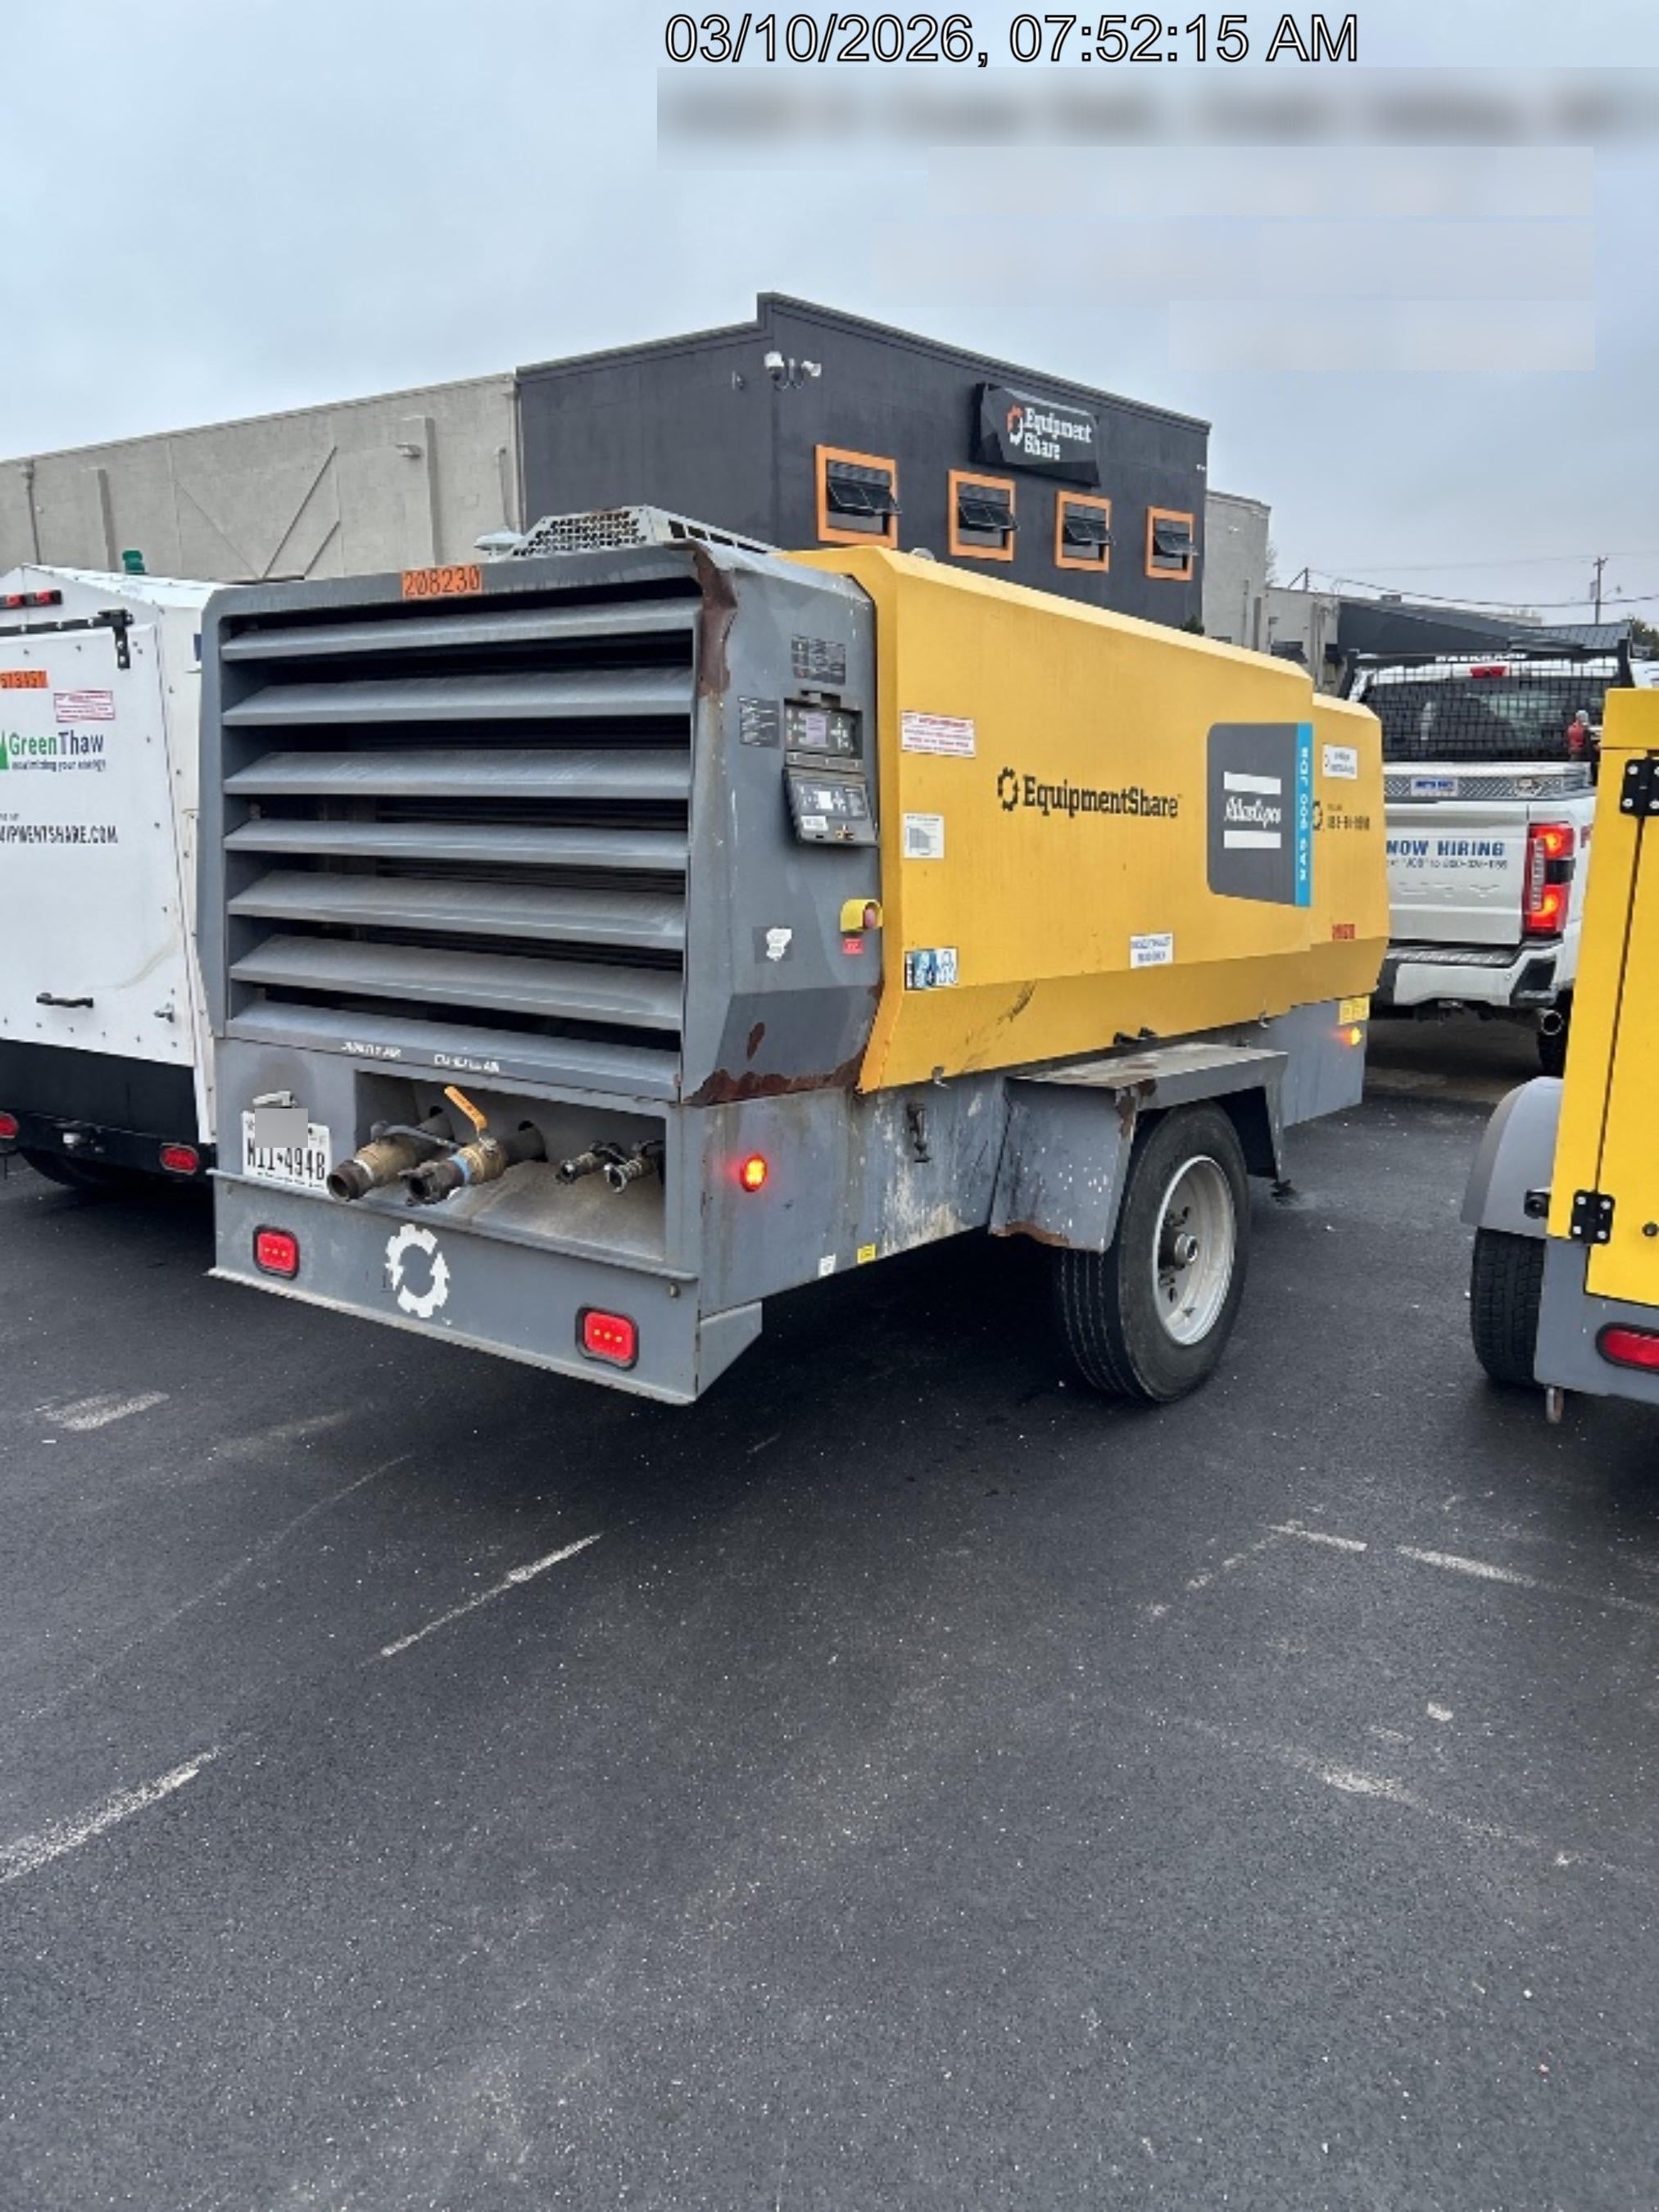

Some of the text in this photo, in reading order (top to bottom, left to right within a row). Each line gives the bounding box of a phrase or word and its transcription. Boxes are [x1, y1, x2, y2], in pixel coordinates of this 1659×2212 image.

[1024, 407, 1092, 443] Equipment
[1024, 432, 1060, 461] Share
[405, 565, 480, 596] 208230
[9, 730, 104, 755] GreenThaw
[1022, 774, 1179, 819] EquipmentShare
[1386, 840, 1505, 856] NOW HIRING
